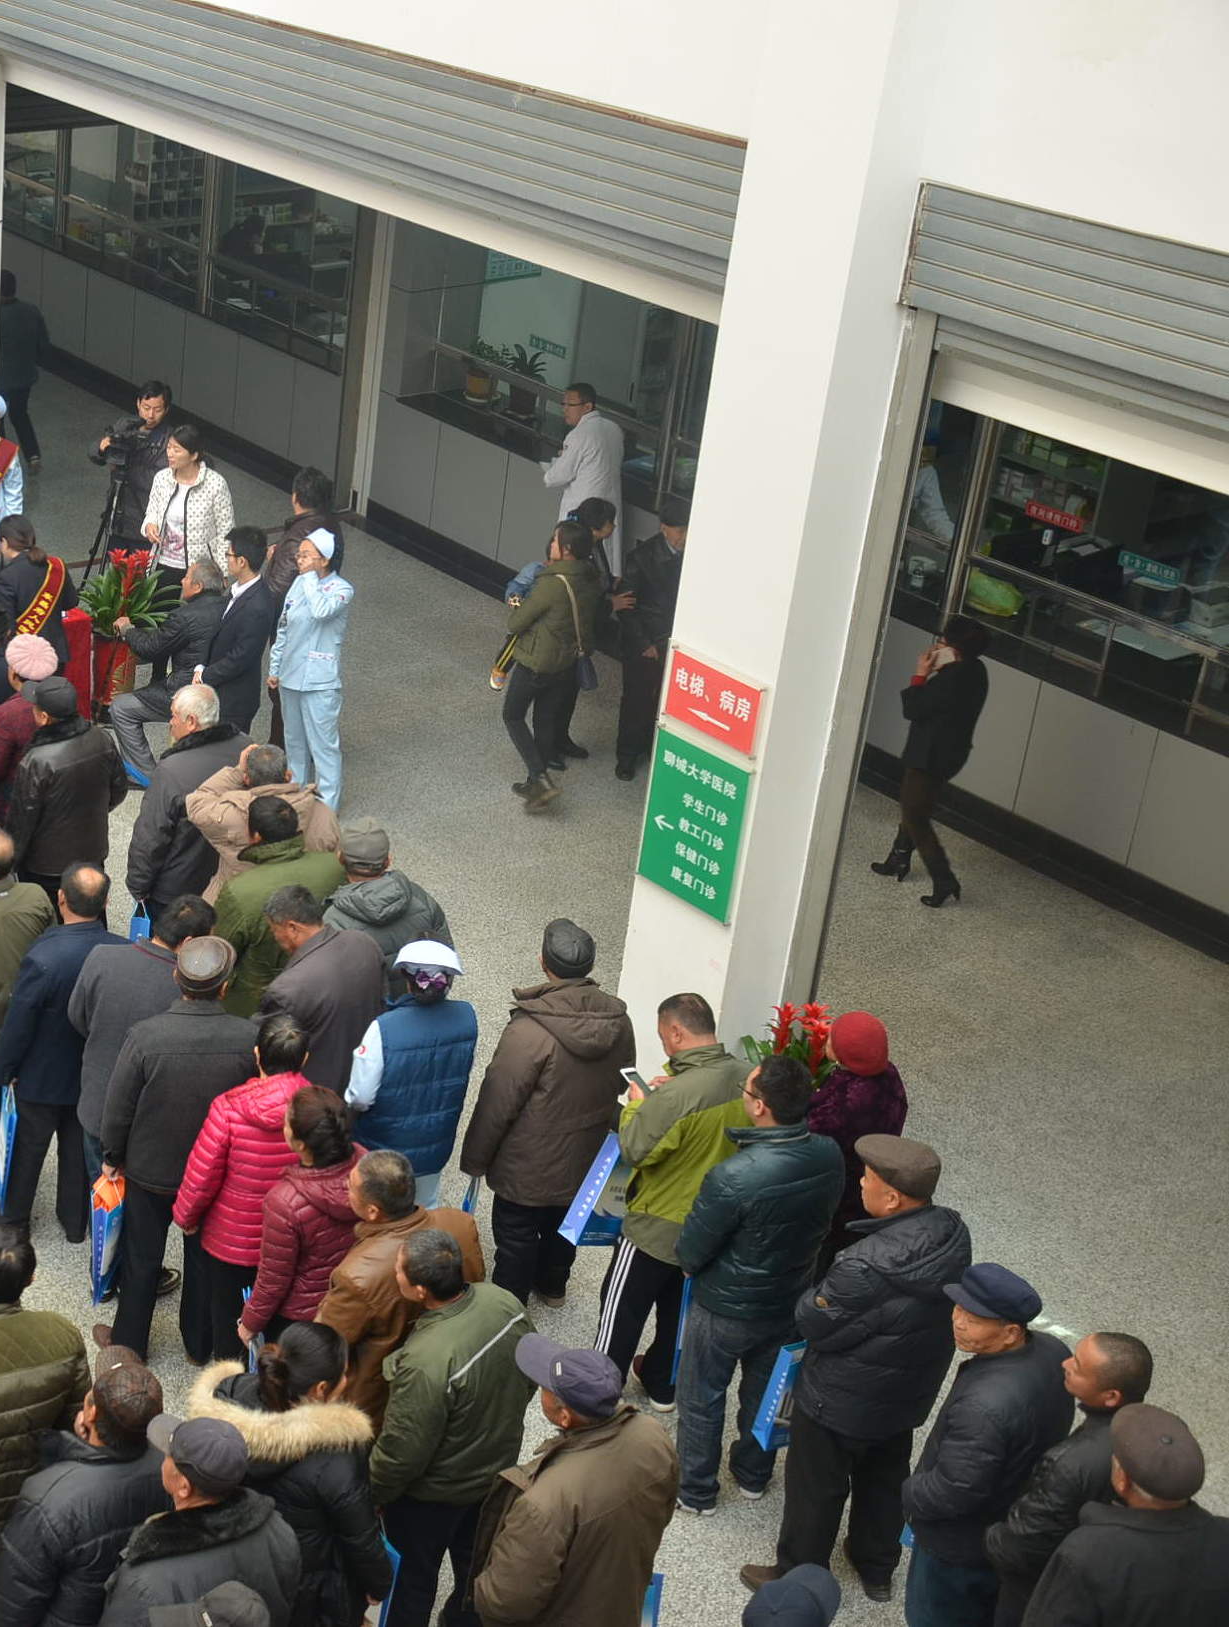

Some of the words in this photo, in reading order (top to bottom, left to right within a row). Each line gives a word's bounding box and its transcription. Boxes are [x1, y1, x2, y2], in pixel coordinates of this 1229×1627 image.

[675, 667, 752, 722] 电梯、病房
[663, 749, 737, 800] 聊城大学医院
[682, 792, 729, 827] 学生门诊
[678, 817, 724, 851] 教工门诊
[675, 841, 721, 876] 保健门诊
[670, 865, 717, 900] 康复门诊
